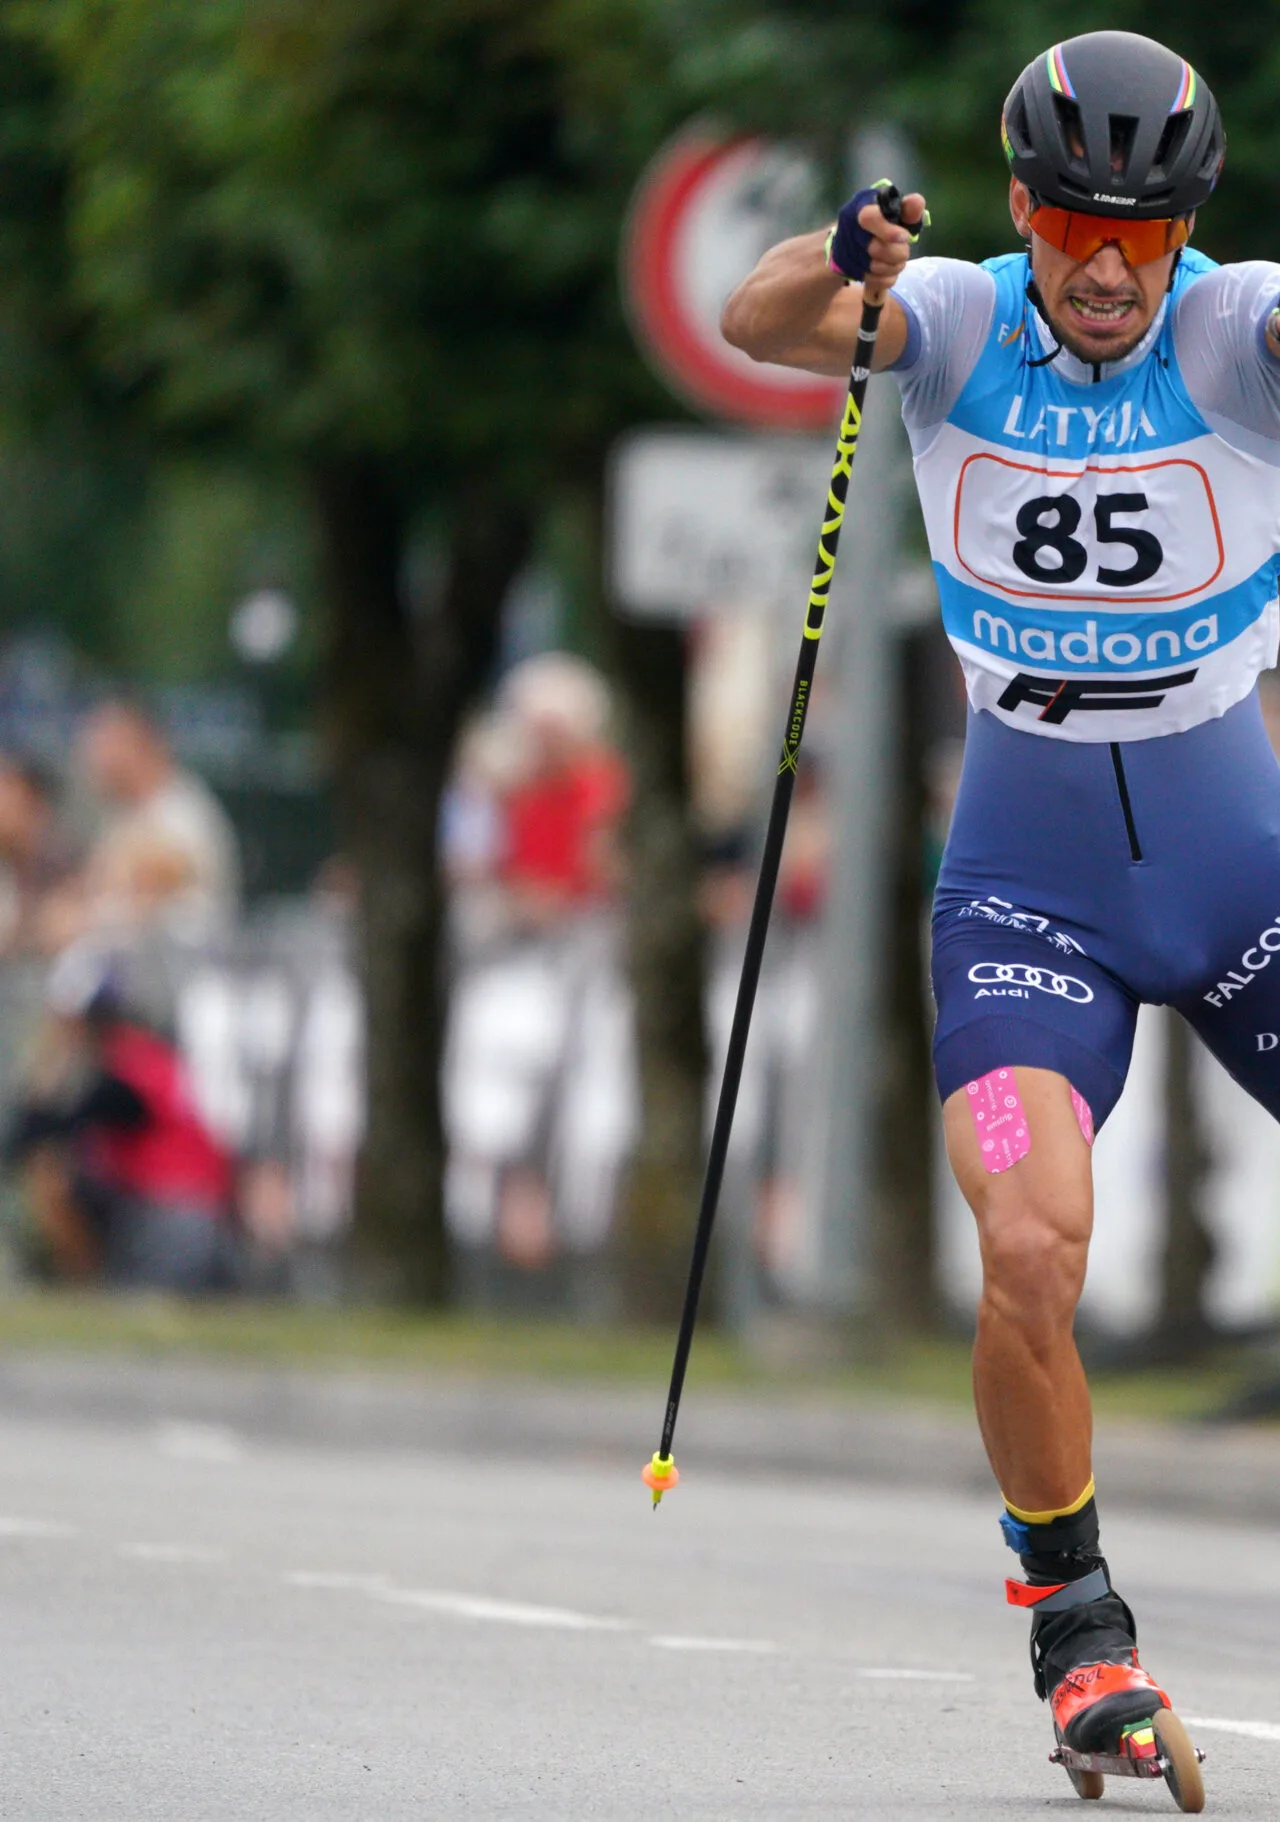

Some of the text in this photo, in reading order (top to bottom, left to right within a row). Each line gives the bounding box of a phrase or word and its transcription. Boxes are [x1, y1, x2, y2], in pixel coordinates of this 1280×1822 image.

[1012, 493, 1163, 587] 85
[973, 609, 1219, 664] madona
[789, 680, 808, 745] BLACKCODE
[974, 988, 1029, 999] Audi
